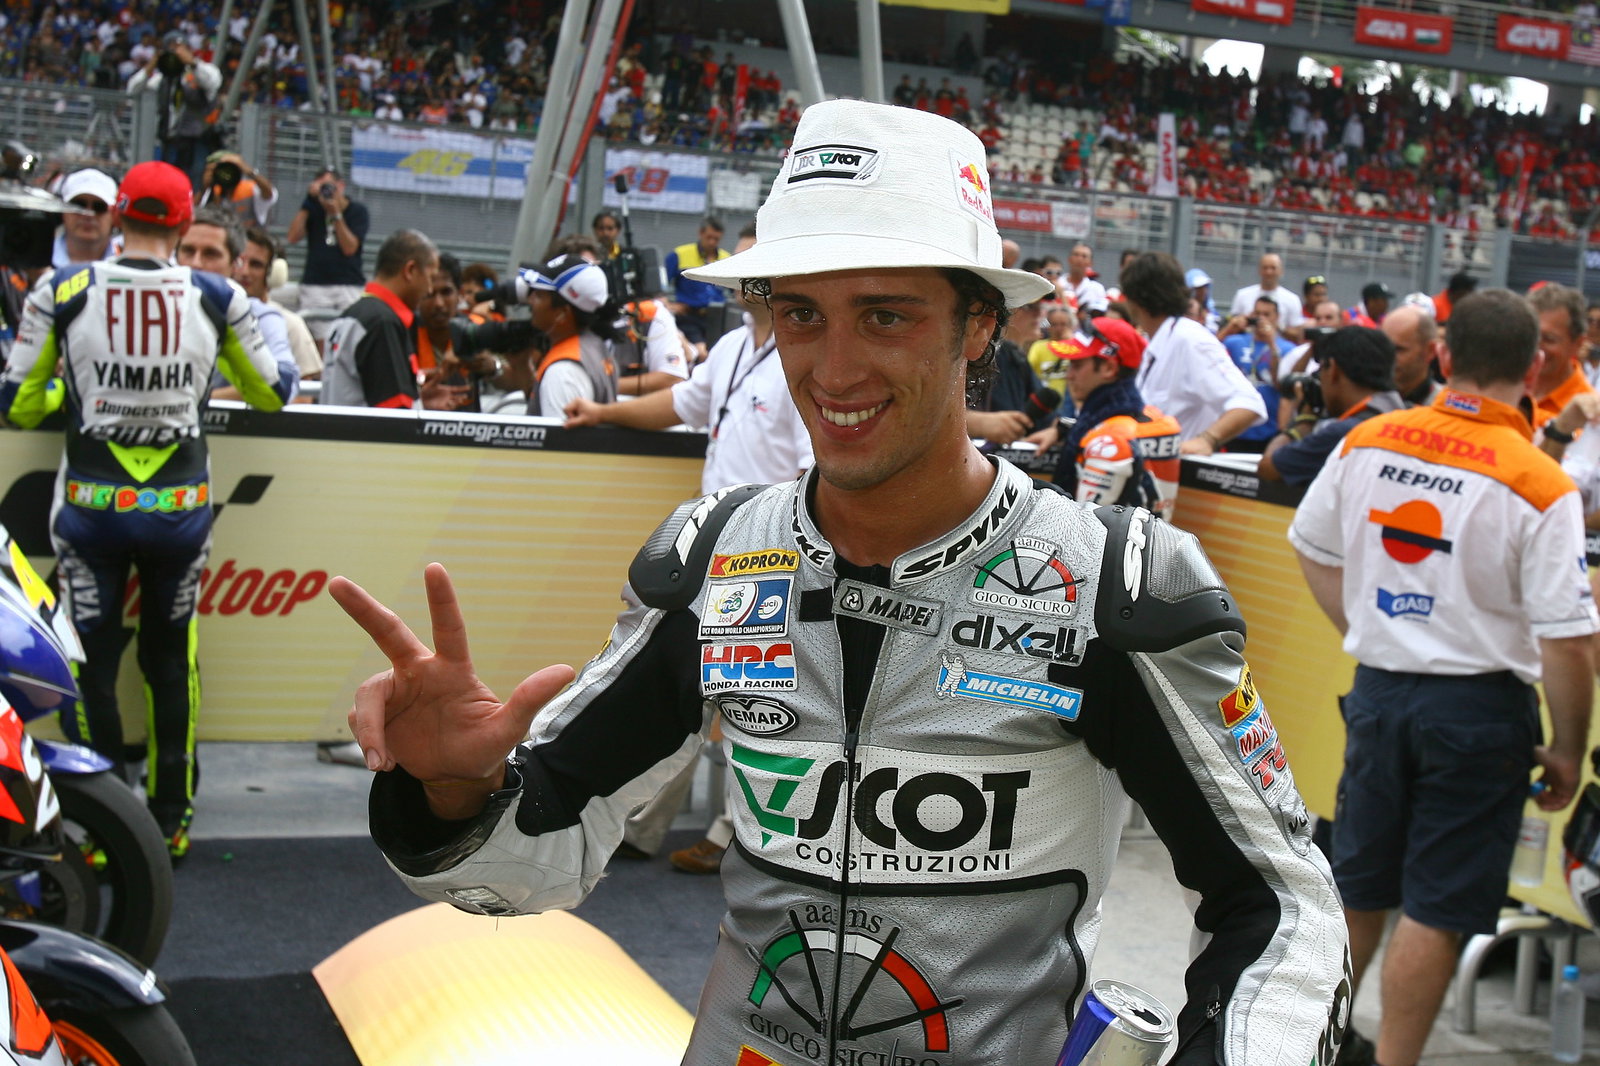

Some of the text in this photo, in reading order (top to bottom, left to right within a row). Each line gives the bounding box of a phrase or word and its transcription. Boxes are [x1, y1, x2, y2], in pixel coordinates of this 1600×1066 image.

[1507, 23, 1560, 50] GIVI
[396, 148, 474, 178] 46
[961, 187, 978, 211] Red
[55, 268, 90, 304] 46
[106, 288, 184, 357] FIAT
[94, 361, 193, 392] YAMAHA
[95, 399, 192, 418] BRIDGESTONE
[423, 420, 547, 443] motogp.com
[1378, 423, 1498, 468] HONDA
[1379, 464, 1465, 496] REPSOL
[68, 481, 115, 511] THE
[898, 480, 1019, 580] SPYKE
[1017, 536, 1053, 552] aams
[729, 552, 796, 573] KOPRON
[868, 595, 936, 627] MAPEI
[974, 590, 1071, 615] GIOCO SICURO
[711, 626, 724, 635] ROAD
[725, 626, 742, 634] WORLD
[743, 624, 784, 634] CHAMPIONSHIPS
[703, 643, 795, 683] HRC
[704, 680, 794, 692] HONDA RACING
[966, 677, 1076, 711] MICHELIN
[722, 705, 784, 725] VEMAR
[797, 760, 1031, 851] SCOT
[795, 843, 1011, 873] COSTRUZIONI
[805, 904, 883, 933] aams
[749, 1013, 822, 1060] GIOCO
